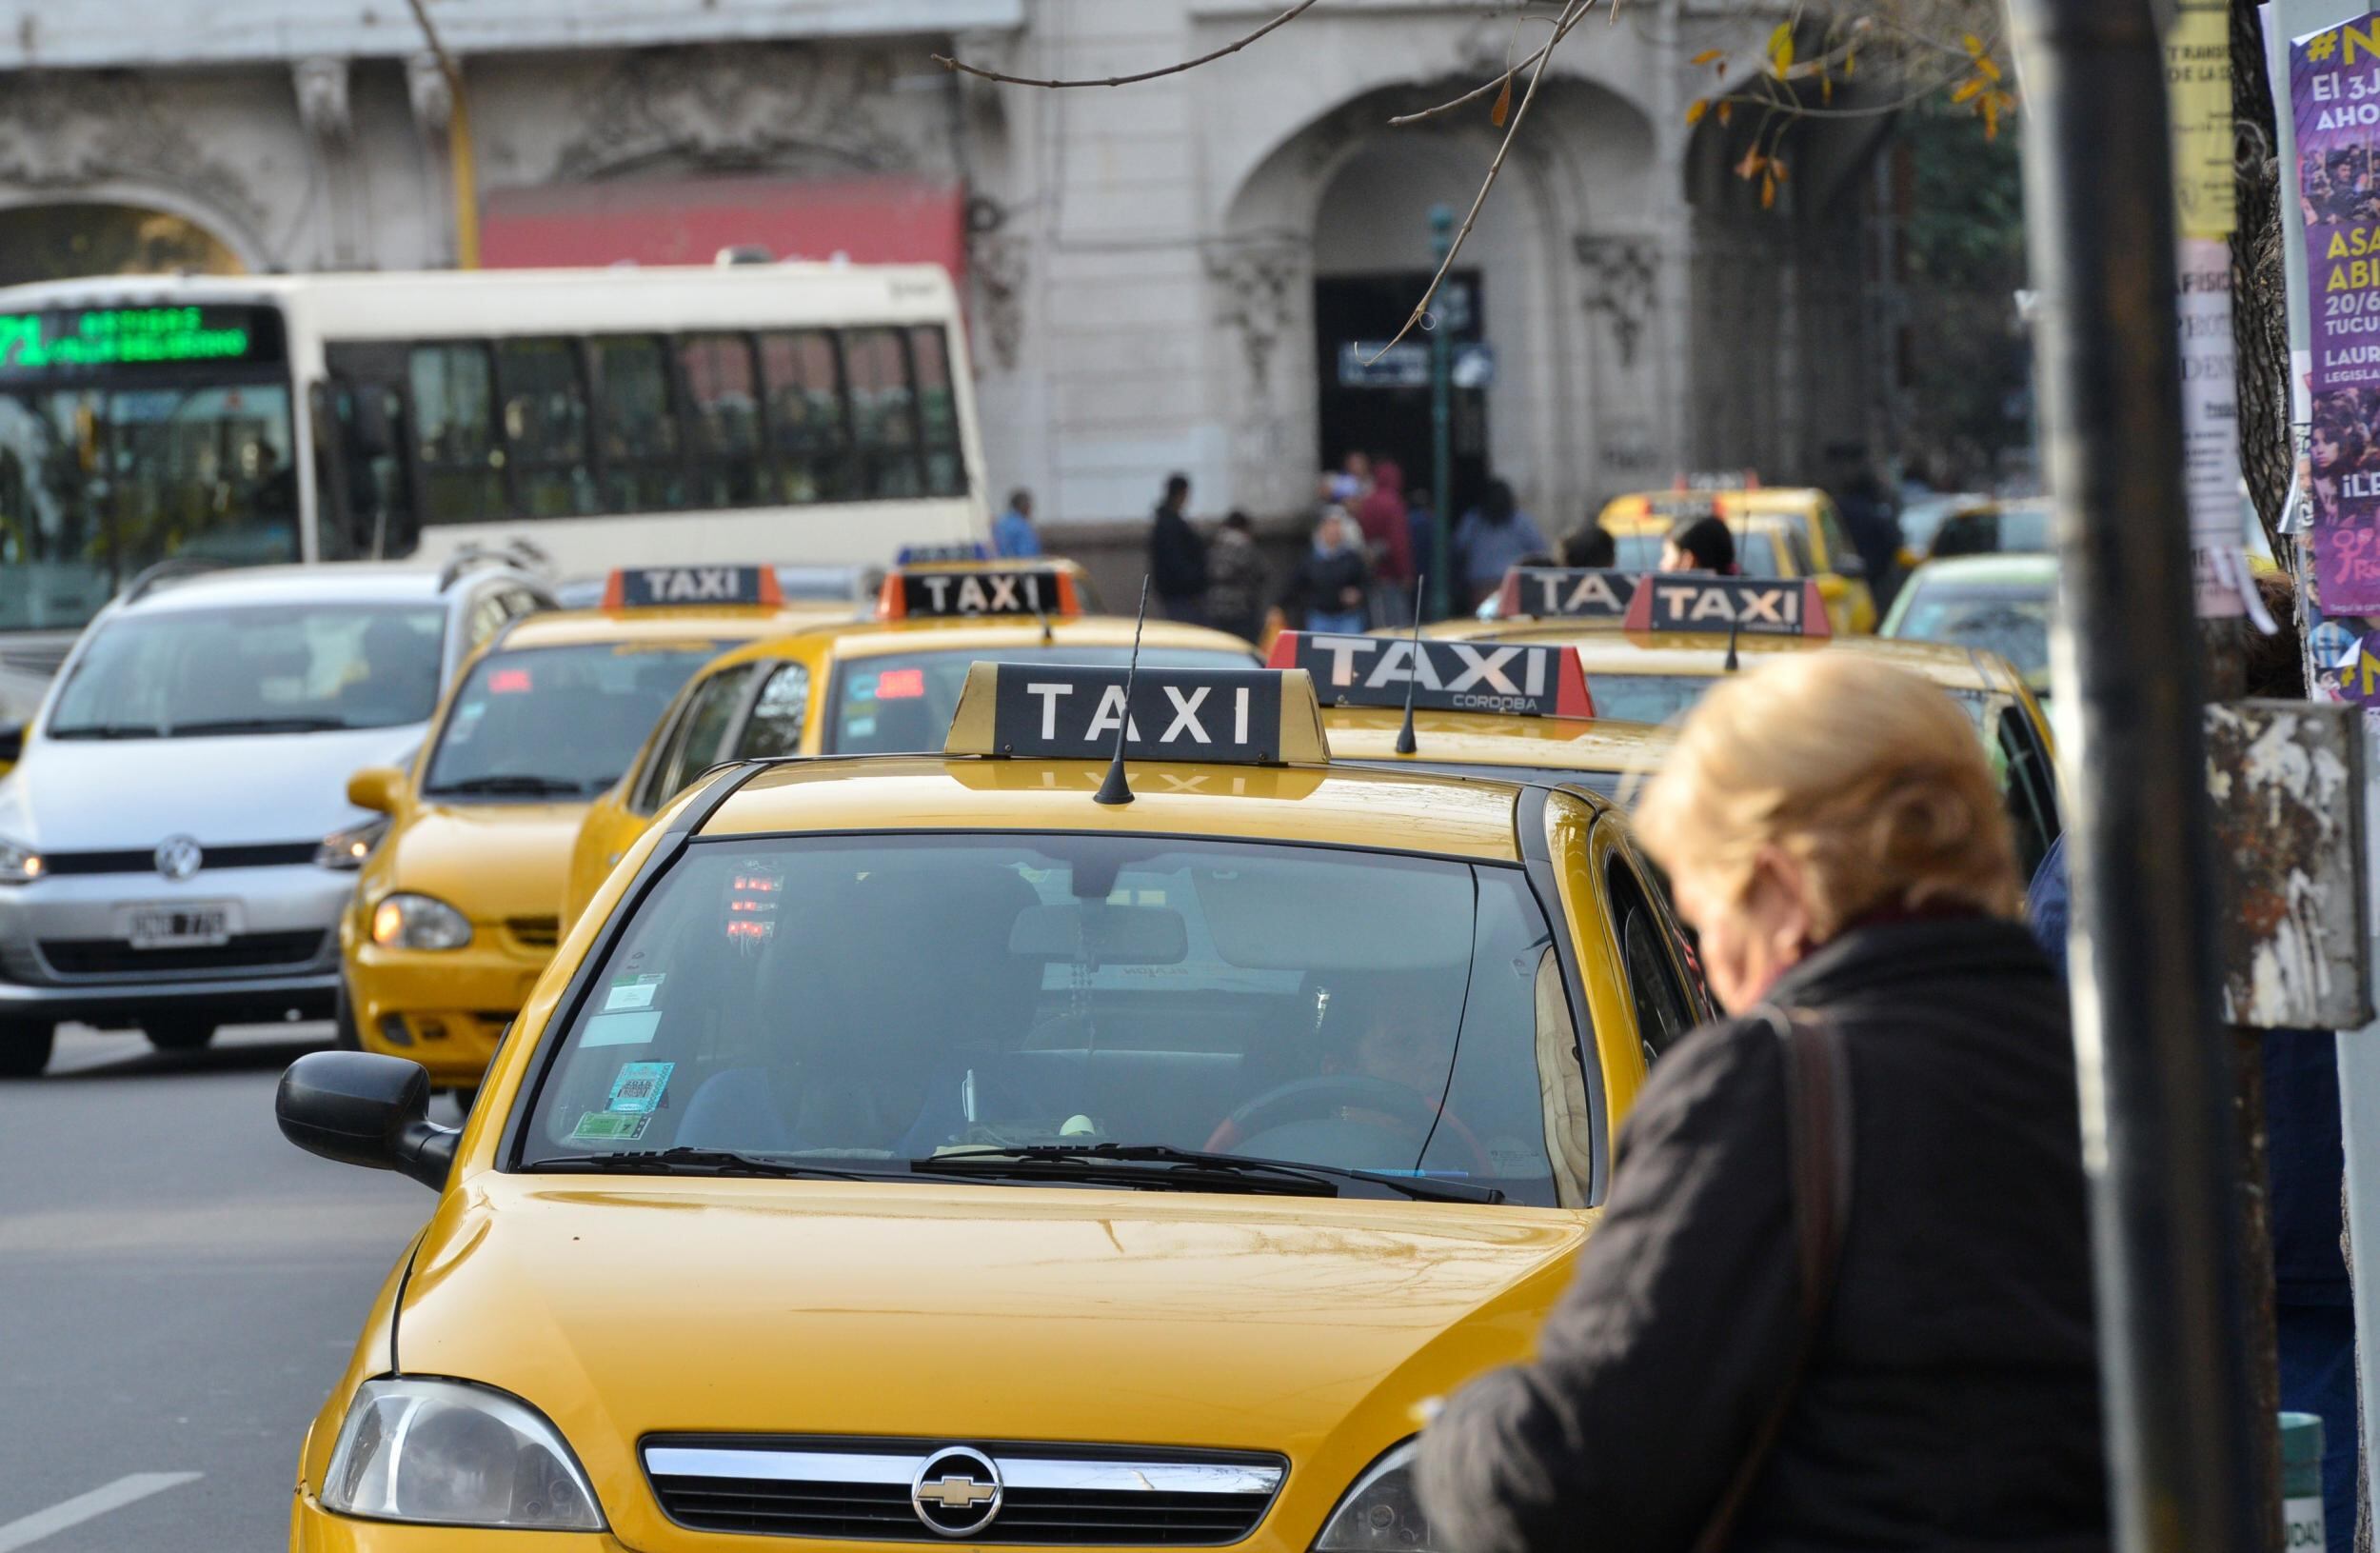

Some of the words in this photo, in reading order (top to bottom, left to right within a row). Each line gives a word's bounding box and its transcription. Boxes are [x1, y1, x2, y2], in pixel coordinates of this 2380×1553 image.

[2307, 16, 2380, 66] #N
[2315, 103, 2380, 130] AHO
[2325, 289, 2380, 317] 20/6
[644, 568, 739, 601] TAXI
[923, 575, 1040, 611] TAXI
[1656, 587, 1798, 624] TAXI
[1312, 636, 1546, 696] TAXI
[1027, 683, 1250, 744] TAXI
[1453, 694, 1537, 710] CORDOBA
